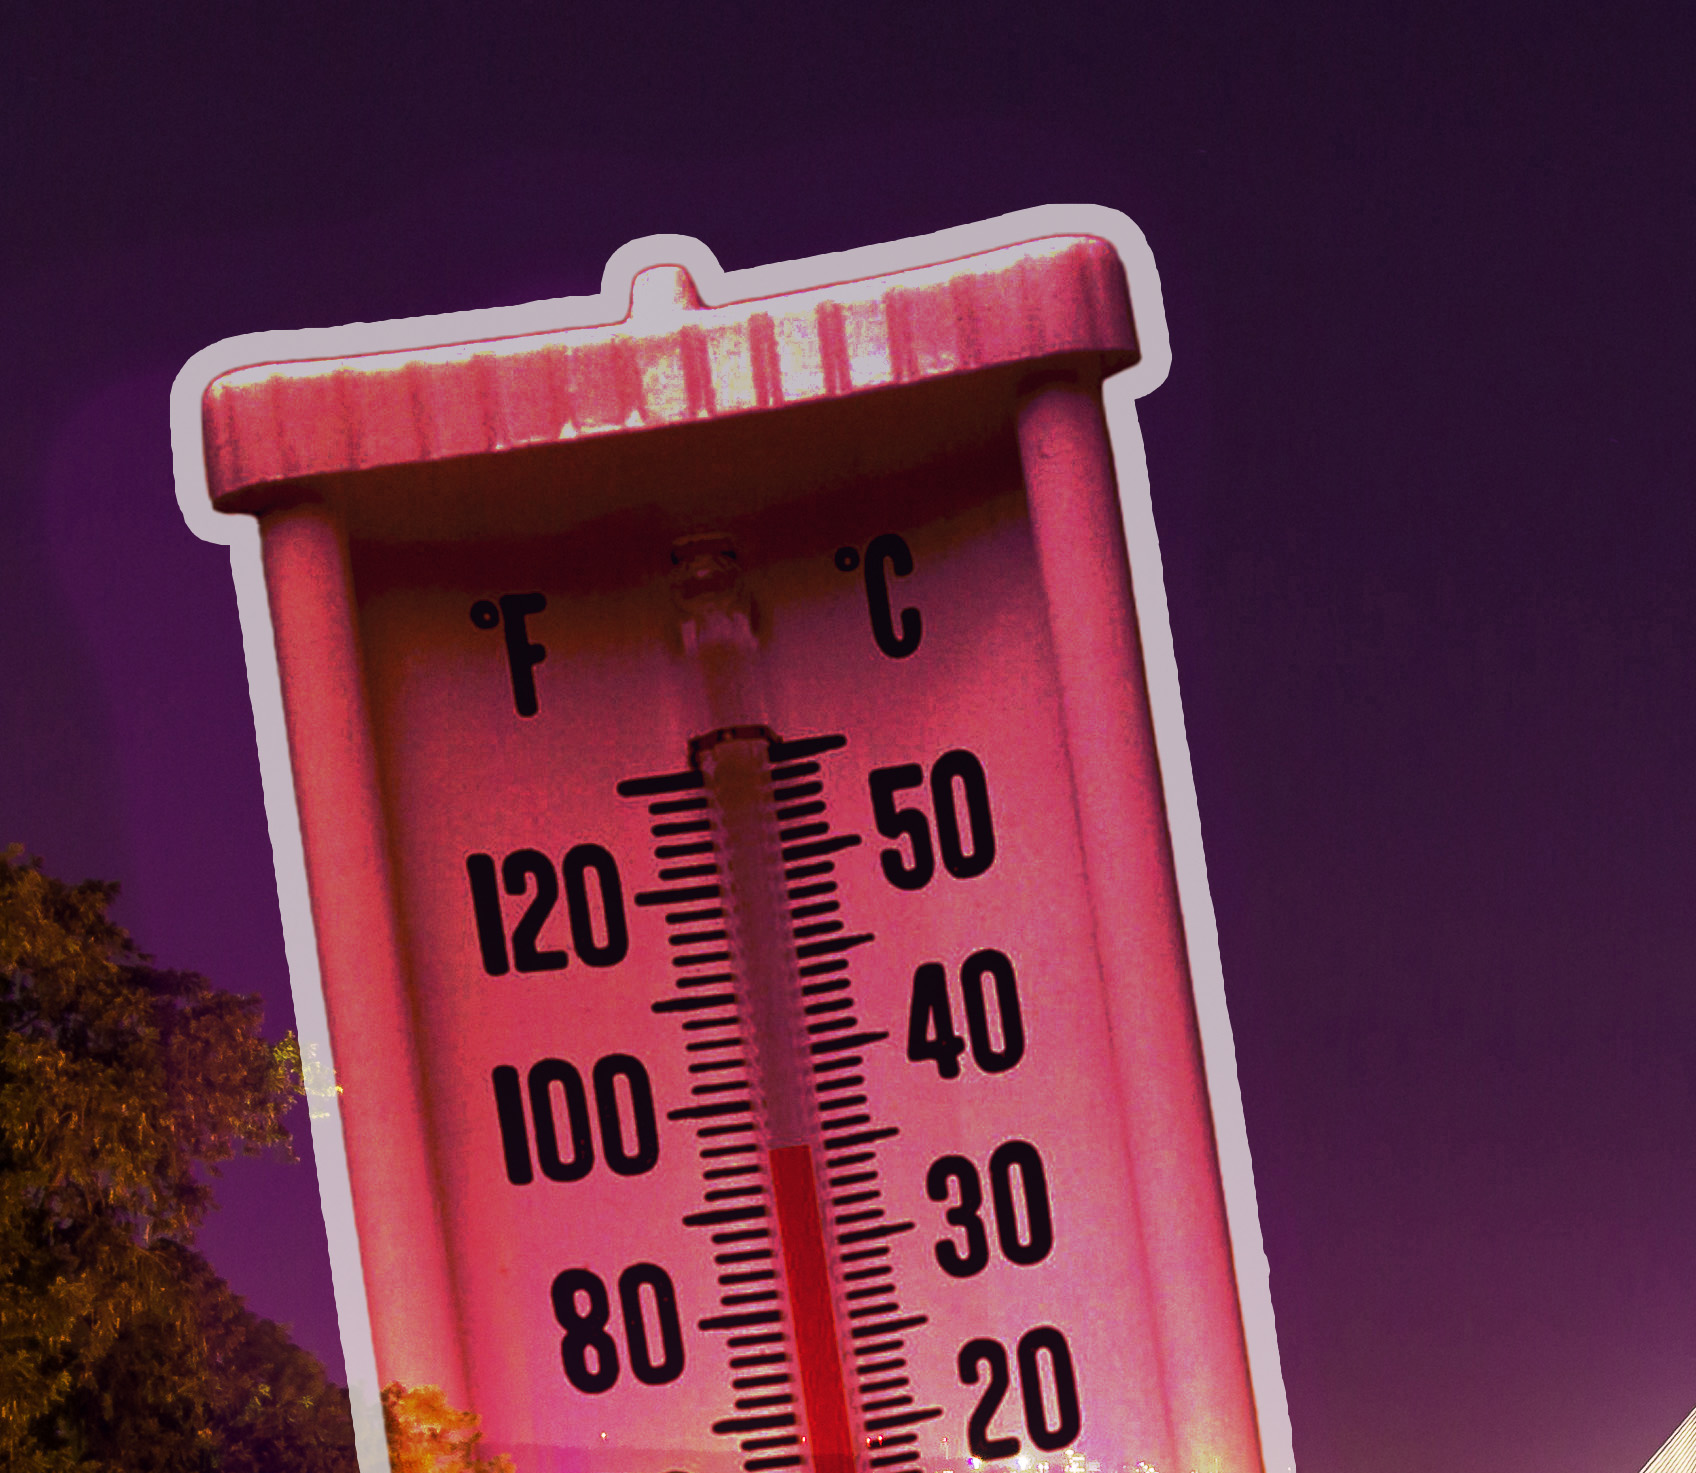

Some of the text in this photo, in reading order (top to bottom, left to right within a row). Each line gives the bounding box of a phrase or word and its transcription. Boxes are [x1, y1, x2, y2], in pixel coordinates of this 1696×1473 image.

[868, 748, 996, 891] 50
[465, 842, 629, 977] 120
[906, 948, 1025, 1080] 40
[491, 1053, 660, 1186] 100
[925, 1139, 1054, 1279] 30
[550, 1262, 686, 1394] 80
[957, 1325, 1083, 1463] 20
